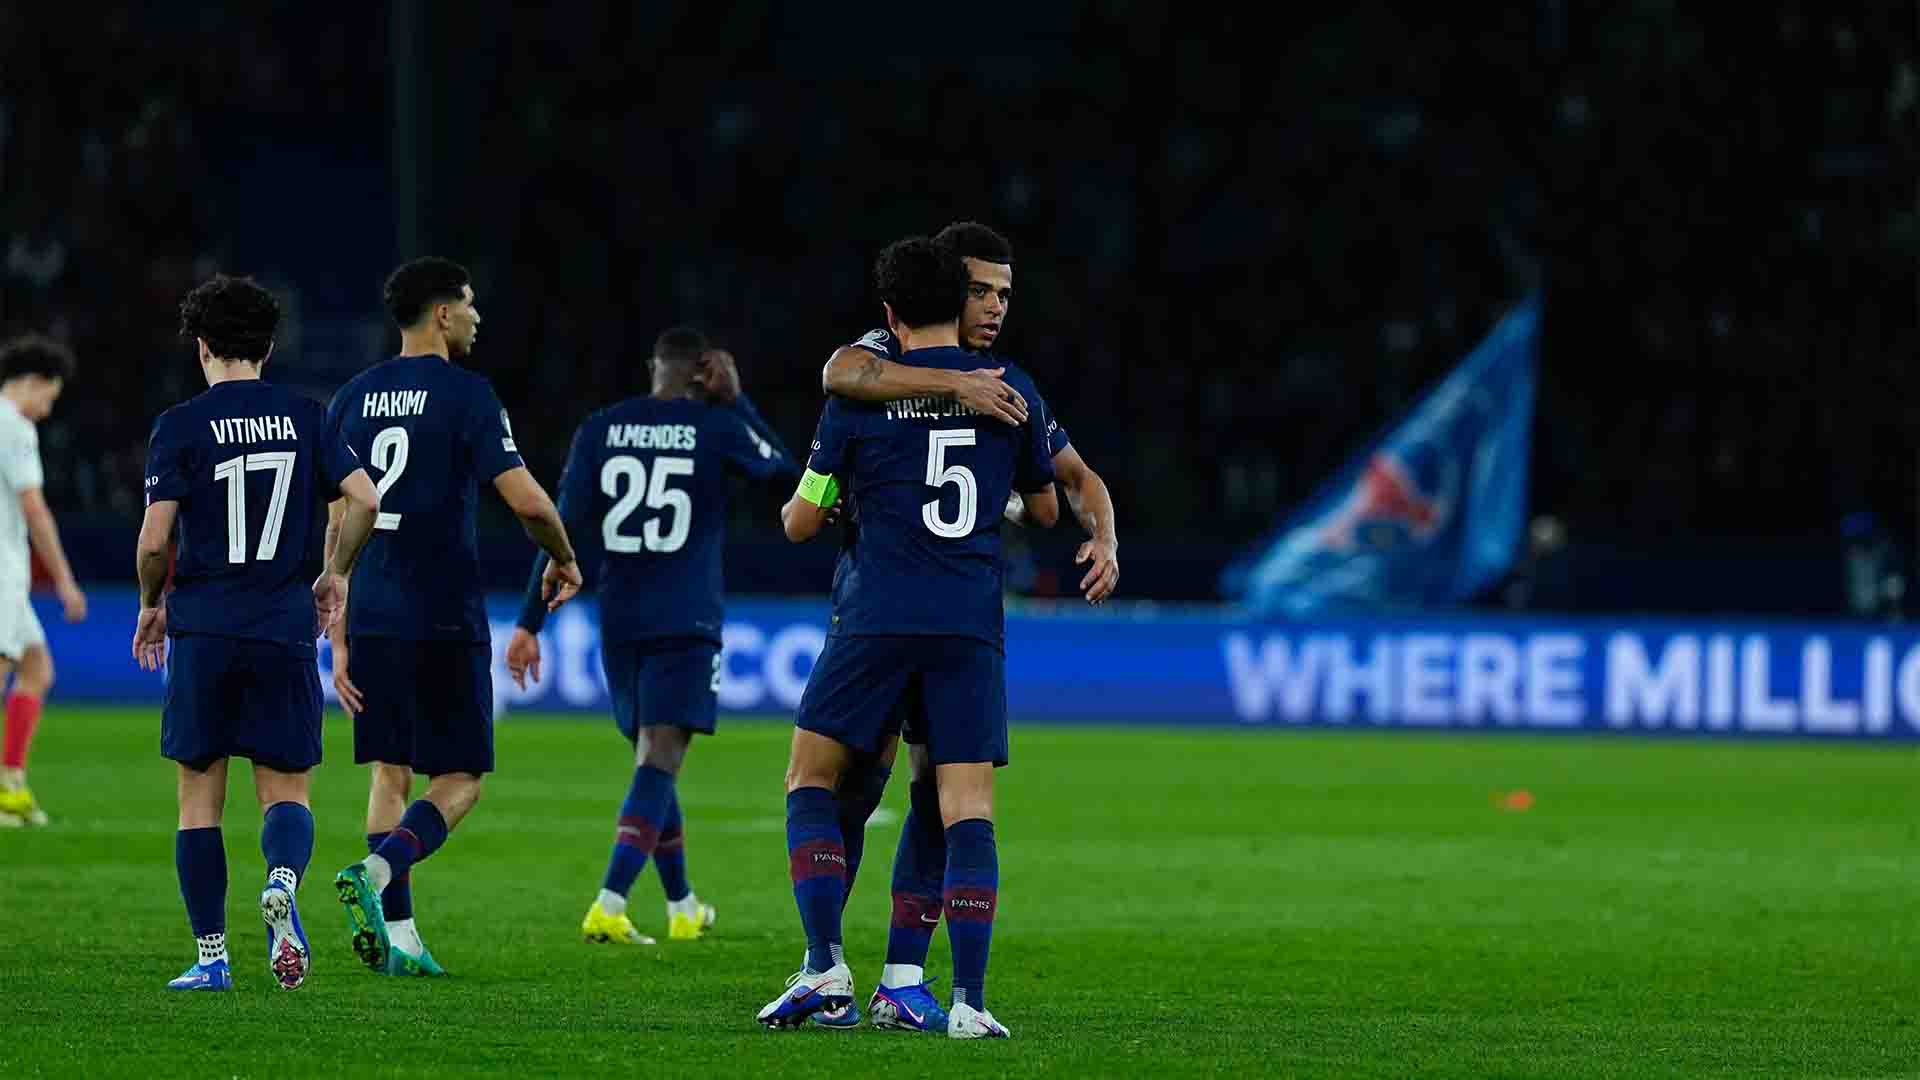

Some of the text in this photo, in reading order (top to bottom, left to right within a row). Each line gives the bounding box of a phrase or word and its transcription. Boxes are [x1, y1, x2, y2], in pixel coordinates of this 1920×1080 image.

[210, 416, 298, 444] VITINHA
[362, 390, 428, 418] HAKIMI
[606, 424, 697, 451] N.MENDES
[214, 451, 297, 564] 17
[371, 426, 410, 531] 2
[600, 455, 695, 553] 25
[921, 429, 977, 538] 5
[1226, 633, 1920, 733] WHERE MILLI
[951, 899, 992, 910] PARIS
